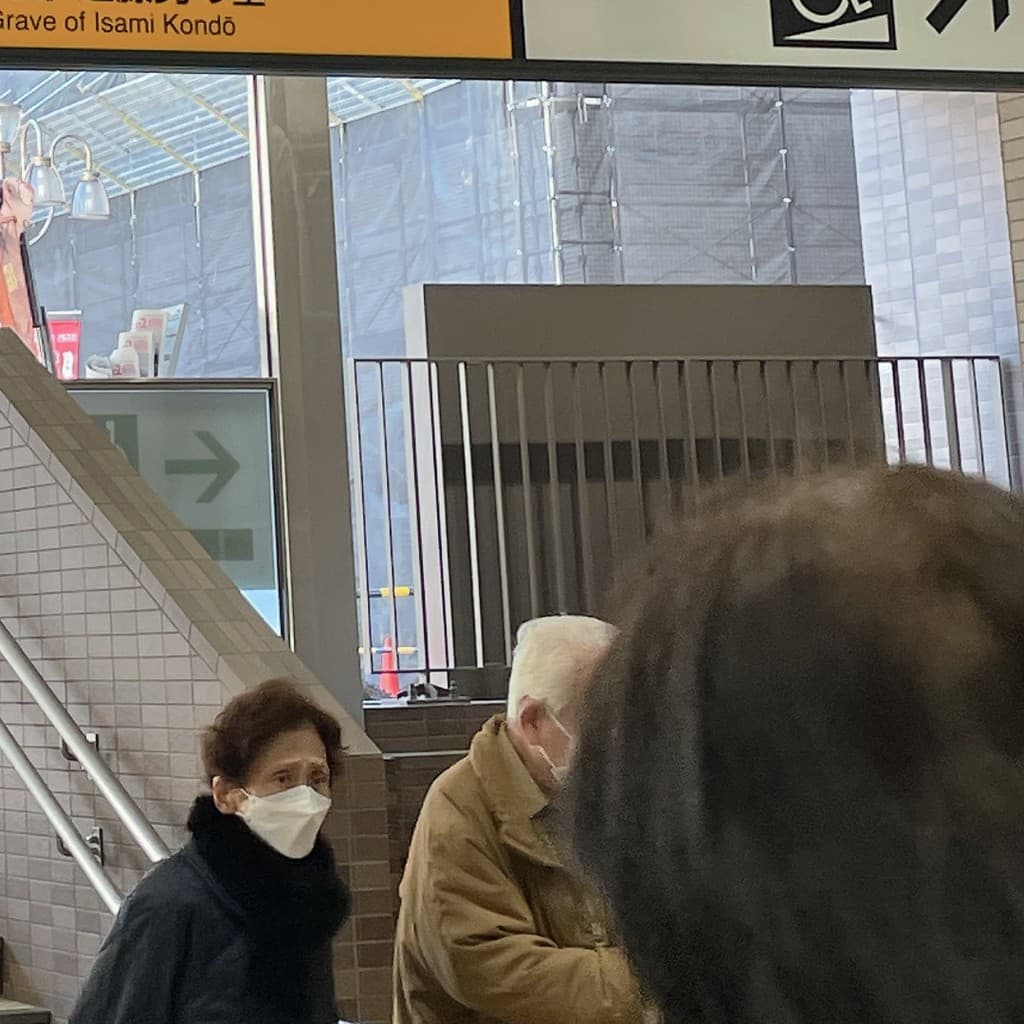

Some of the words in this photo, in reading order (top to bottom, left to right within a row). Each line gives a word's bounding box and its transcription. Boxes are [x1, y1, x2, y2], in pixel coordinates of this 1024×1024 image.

[64, 10, 86, 32] of
[95, 11, 155, 34] Isami
[163, 13, 236, 37] Kondō
